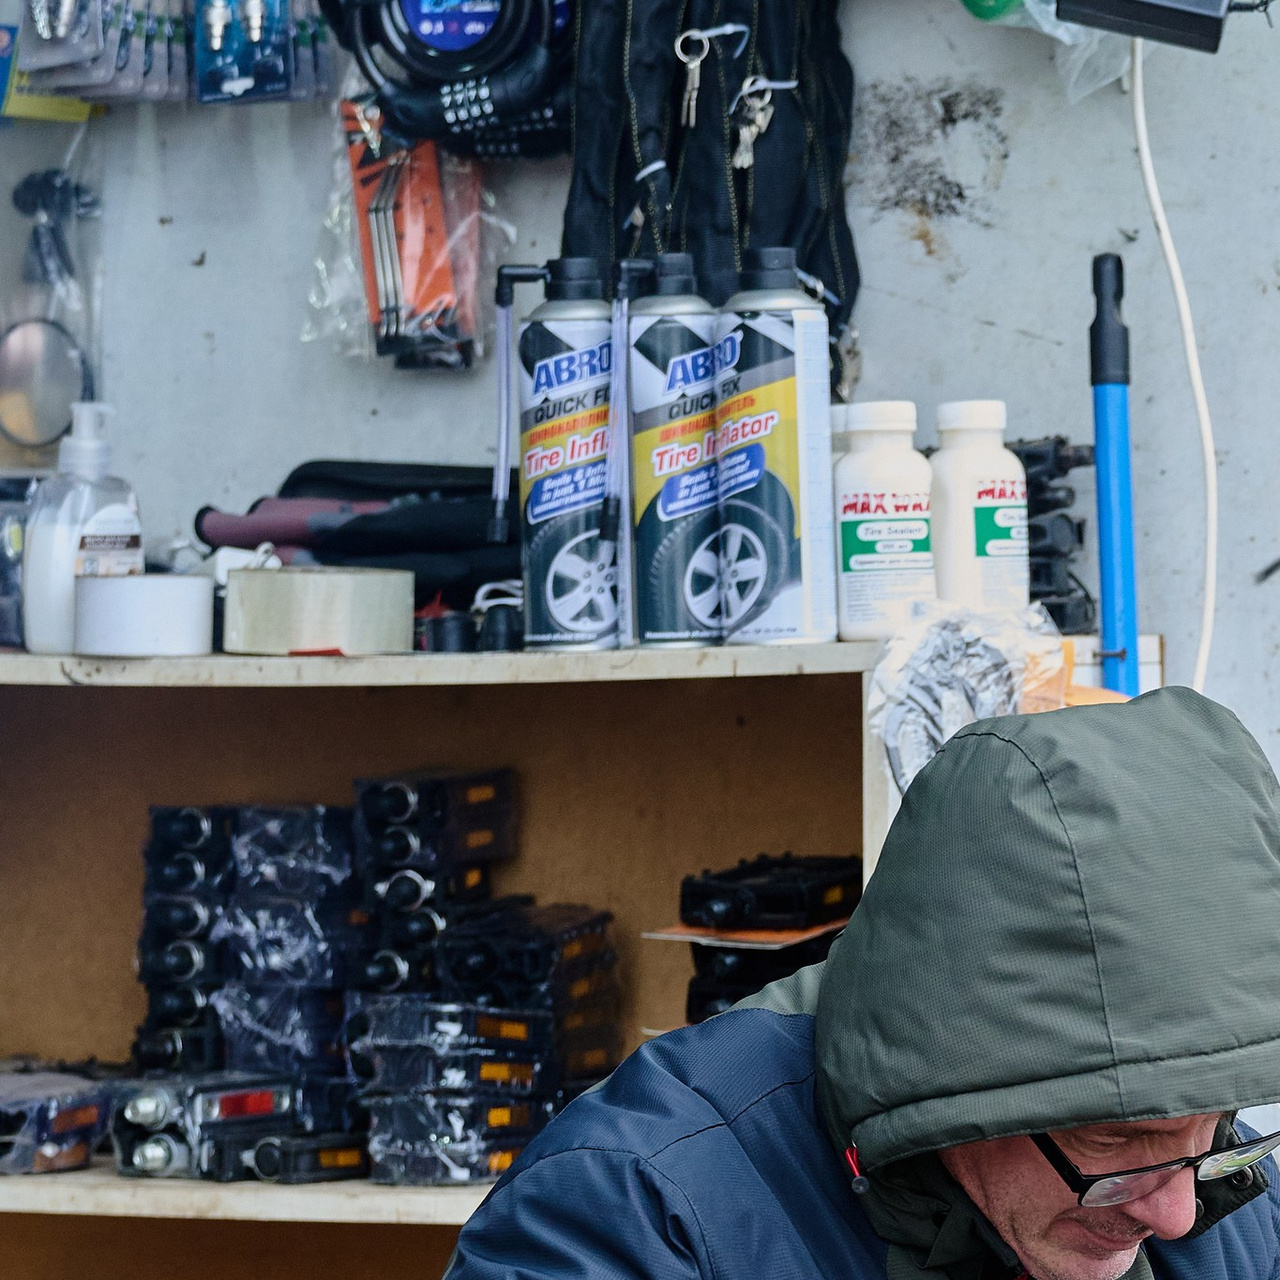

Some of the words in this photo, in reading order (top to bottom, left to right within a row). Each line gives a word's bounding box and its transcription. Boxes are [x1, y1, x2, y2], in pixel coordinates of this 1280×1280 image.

[534, 341, 612, 395] ABRO
[666, 333, 742, 392] ABRO
[535, 392, 589, 423] QUICK
[594, 385, 610, 406] FI
[527, 449, 560, 475] Tire
[655, 449, 698, 473] Tire
